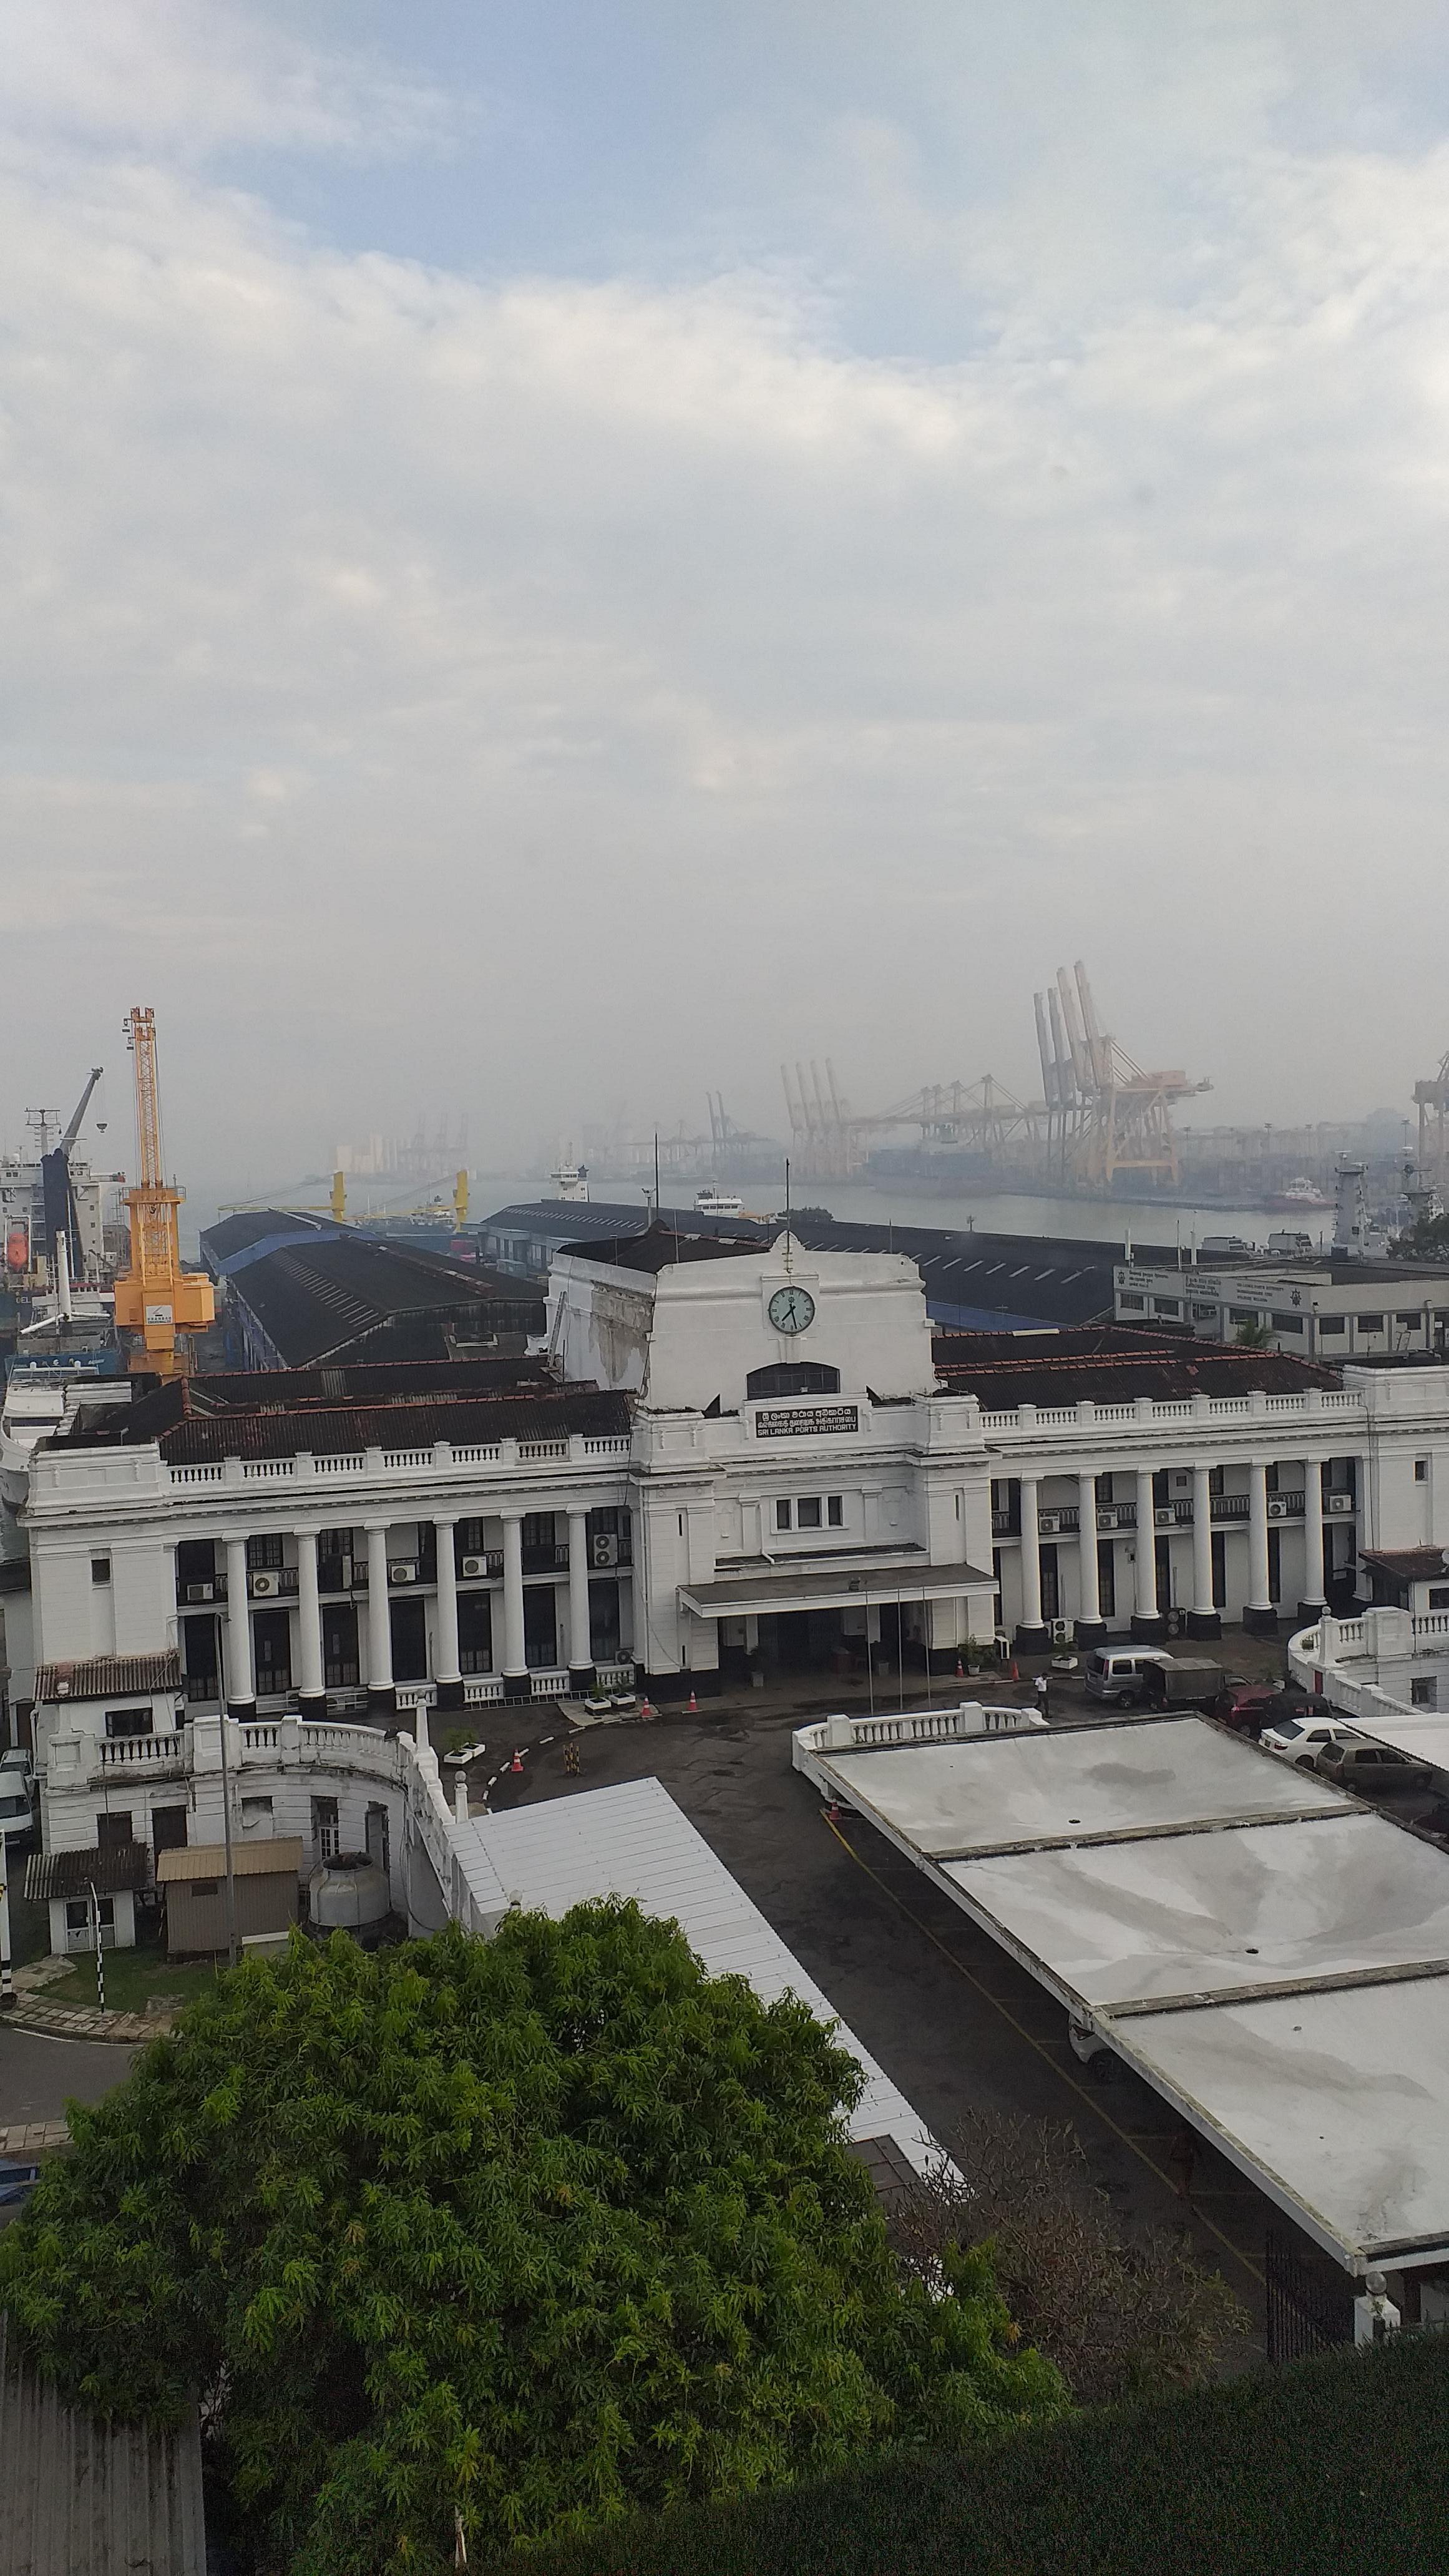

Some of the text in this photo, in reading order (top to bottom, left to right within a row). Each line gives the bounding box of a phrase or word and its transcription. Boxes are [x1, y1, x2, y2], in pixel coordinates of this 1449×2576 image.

[771, 1412, 790, 1421] ලංකා
[792, 1410, 814, 1418] වරාය
[770, 1427, 793, 1435] LANKA
[795, 1426, 818, 1434] PORTS
[819, 1423, 856, 1432] AUTHORITY
